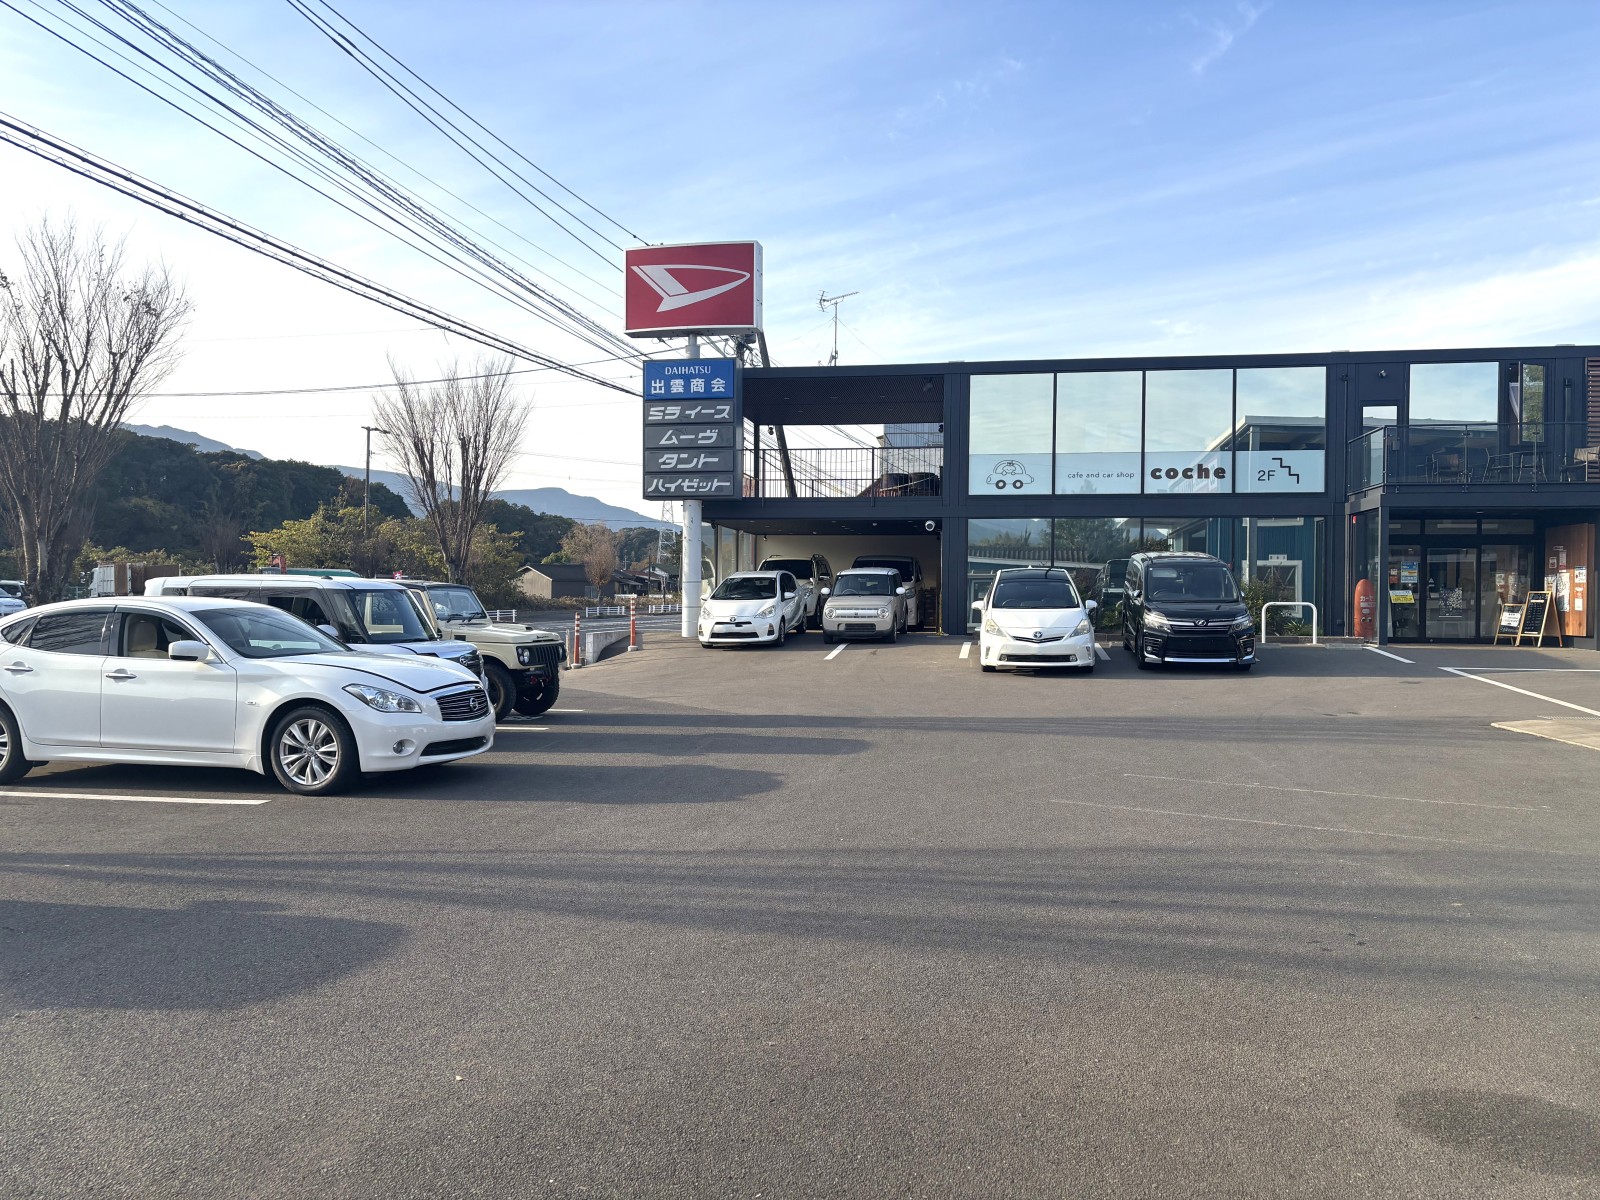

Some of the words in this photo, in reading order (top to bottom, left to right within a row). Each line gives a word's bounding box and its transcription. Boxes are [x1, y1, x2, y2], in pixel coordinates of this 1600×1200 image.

[665, 366, 711, 375] DAIHATSU
[651, 377, 726, 394] 出雲商会
[659, 429, 719, 445] ムーヴ
[658, 453, 719, 469] タント
[1150, 463, 1226, 480] coche
[1257, 469, 1276, 481] 2F
[647, 478, 731, 492] ハイゼット
